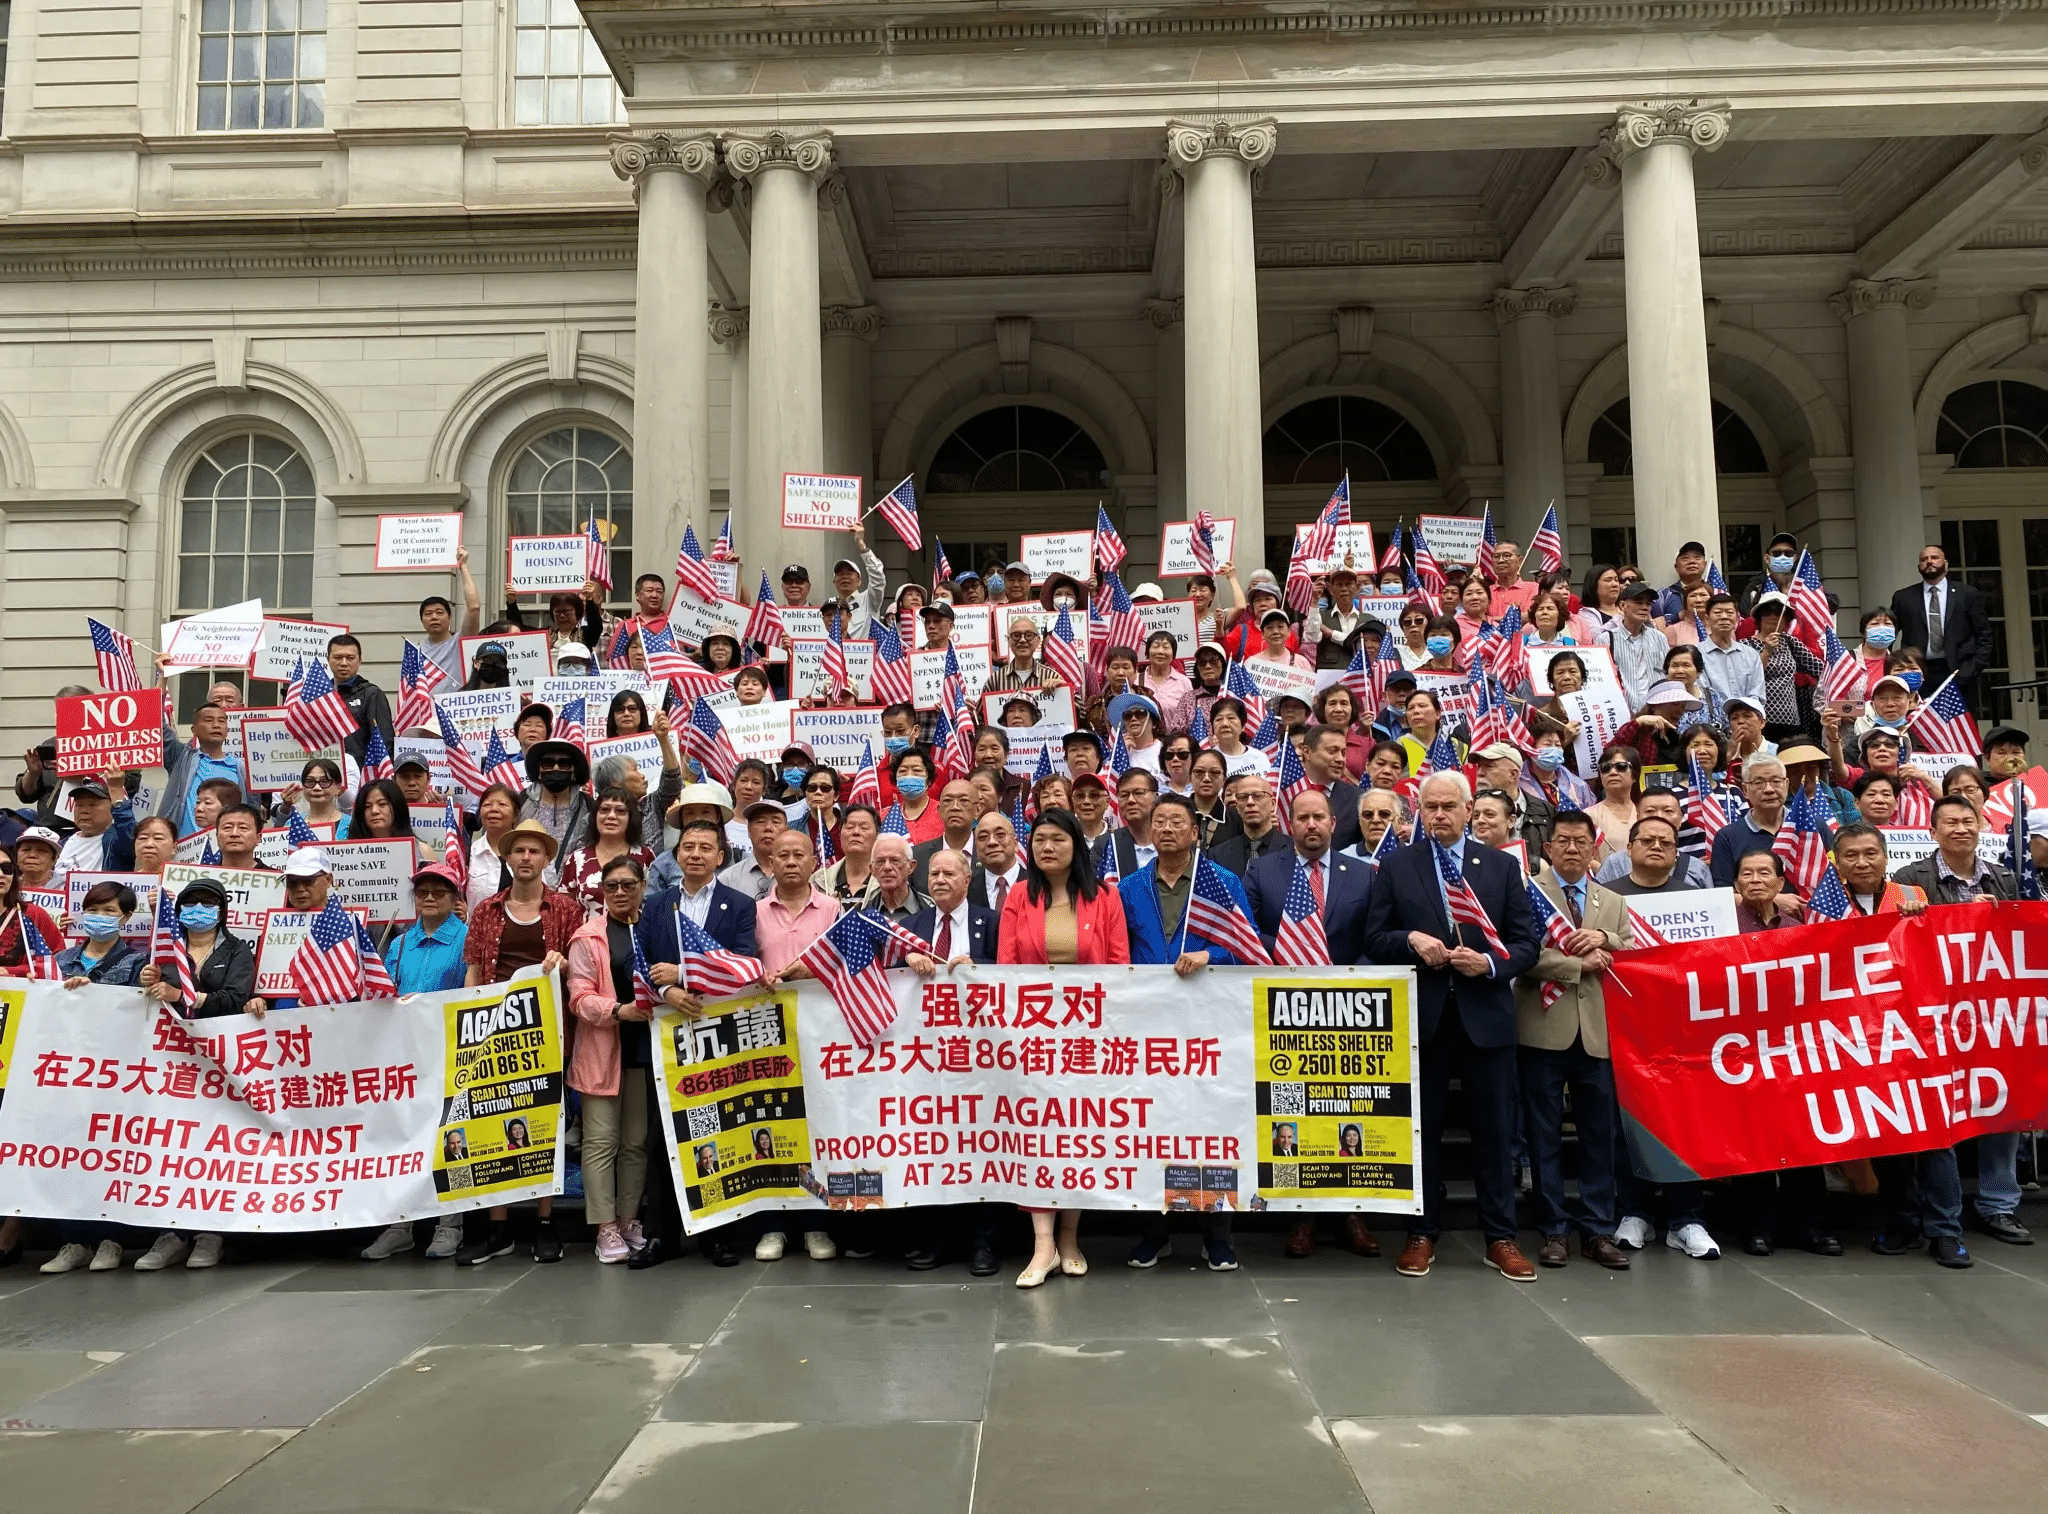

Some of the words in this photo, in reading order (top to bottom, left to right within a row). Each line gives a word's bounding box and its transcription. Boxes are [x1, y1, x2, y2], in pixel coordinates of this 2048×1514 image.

[790, 476, 816, 486] SAFE
[818, 478, 856, 489] HOMES
[788, 488, 812, 497] SAFE
[813, 490, 858, 500] SCHOOLS
[810, 500, 831, 513] NO
[786, 512, 857, 527] SHELTERS!
[1436, 528, 1463, 536] Shelters
[513, 540, 583, 552] AFFORDABLE
[1046, 538, 1066, 546] Keep
[1170, 537, 1184, 546] Our
[1426, 539, 1468, 549] Playgrounds
[1045, 548, 1068, 556] Streets
[1068, 546, 1084, 554] Safe
[1438, 552, 1467, 560] Schools!
[525, 556, 573, 568] HOUSING
[1046, 558, 1065, 567] Keep
[1168, 560, 1197, 569] Shelters
[512, 576, 532, 586] NOT
[534, 574, 585, 585] SHELTERS
[680, 600, 696, 612] Our
[696, 606, 722, 621] Streets
[724, 614, 739, 628] Safe
[782, 610, 805, 619] Public
[1156, 606, 1181, 614] Safety
[278, 622, 302, 632] Mayor
[303, 626, 329, 635] Adams,
[792, 624, 821, 633] FIRST!
[280, 634, 302, 643] Please
[304, 637, 324, 646] SAVE
[203, 643, 222, 652] NO
[271, 646, 289, 654] OUR
[172, 653, 244, 663] SHELTERS!
[521, 650, 538, 659] Safe
[797, 656, 811, 664] No
[959, 652, 974, 661] City
[268, 658, 291, 666] STOP
[913, 667, 944, 678] SPENDS
[1250, 664, 1259, 672] WE
[1260, 666, 1270, 674] ARE
[1271, 668, 1288, 678] DOING
[544, 681, 616, 691] CHILDREN'S
[1262, 677, 1277, 688] FAIR
[441, 692, 512, 708] CHILDREN'S
[919, 694, 934, 702] with
[82, 696, 138, 730] NO
[482, 704, 515, 716] FIRST!
[1574, 695, 1591, 723] ZERO
[795, 714, 880, 726] AFFORDABLE
[56, 728, 161, 754] HOMELESS
[248, 732, 271, 742] Help
[274, 730, 290, 740] the
[742, 734, 760, 744] NO
[810, 733, 868, 746] HOUSING
[57, 748, 162, 774] SHELTERS!
[252, 752, 266, 763] By
[1917, 756, 1938, 764] York
[1940, 756, 1958, 766] City
[252, 774, 267, 783] Not
[1890, 834, 1914, 842] KIDS
[254, 850, 280, 859] Please
[326, 847, 354, 856] Mayor
[357, 846, 390, 855] Adams,
[332, 862, 358, 872] Please
[360, 861, 386, 870] SAVE
[348, 876, 399, 888] Community
[351, 893, 398, 903] SHELTER
[272, 915, 306, 927] SAFE
[1670, 926, 1716, 939] FIRST!
[266, 934, 297, 945] SAFE
[1686, 942, 1902, 1021] LITTLE
[921, 982, 1106, 1030] 强烈反对
[1272, 991, 1388, 1028] AGAINST
[677, 1002, 782, 1066] 抗議
[493, 1030, 546, 1056] SHELTER
[1270, 1034, 1336, 1051] HOMELESS
[1339, 1034, 1393, 1052] SHELTER
[820, 1036, 1222, 1080] 在25大道86街建游民所
[454, 1068, 470, 1090] @
[500, 1055, 518, 1074] 86
[522, 1050, 545, 1070] ST.
[1270, 1054, 1292, 1076] @
[1298, 1054, 1336, 1076] 2501
[1340, 1055, 1362, 1075] 86
[1366, 1055, 1390, 1076] ST.
[683, 1056, 790, 1097] 86街遊民所
[471, 1088, 496, 1102] SCAN
[496, 1085, 508, 1097] TO
[509, 1080, 531, 1096] SIGN
[530, 1078, 548, 1092] THE
[1308, 1085, 1334, 1098] SCAN
[1336, 1086, 1348, 1098] TO
[1349, 1086, 1372, 1098] SIGN
[1373, 1086, 1391, 1099] THE
[472, 1098, 512, 1116] PETITION
[513, 1093, 534, 1107] NOW
[1309, 1100, 1350, 1113] PETITION
[1352, 1100, 1374, 1112] NOW
[1805, 1066, 2008, 1146] UNITED
[879, 1094, 983, 1128] FIGHT
[993, 1096, 1153, 1128] AGAINST
[88, 1113, 200, 1150] FIGHT
[204, 1124, 363, 1157] AGAINST
[815, 1131, 949, 1161] PROPOSED
[957, 1130, 1106, 1159] HOMELESS
[1115, 1135, 1240, 1160] SHELTER
[0, 1143, 152, 1175] PROPOSED
[160, 1154, 320, 1185] HOMELESS
[325, 1151, 424, 1182] SHELTER
[475, 1169, 500, 1177] FOLLOW
[903, 1162, 934, 1187] AT
[941, 1162, 973, 1185] 25
[981, 1161, 1027, 1188] AVE
[1034, 1164, 1055, 1189] &
[1062, 1166, 1096, 1190] 86
[1103, 1166, 1137, 1190] ST
[104, 1180, 132, 1203] AT
[134, 1184, 170, 1207] 25
[176, 1187, 237, 1212] AVE
[242, 1191, 266, 1213] &
[272, 1190, 305, 1213] 86
[312, 1189, 343, 1212] ST
